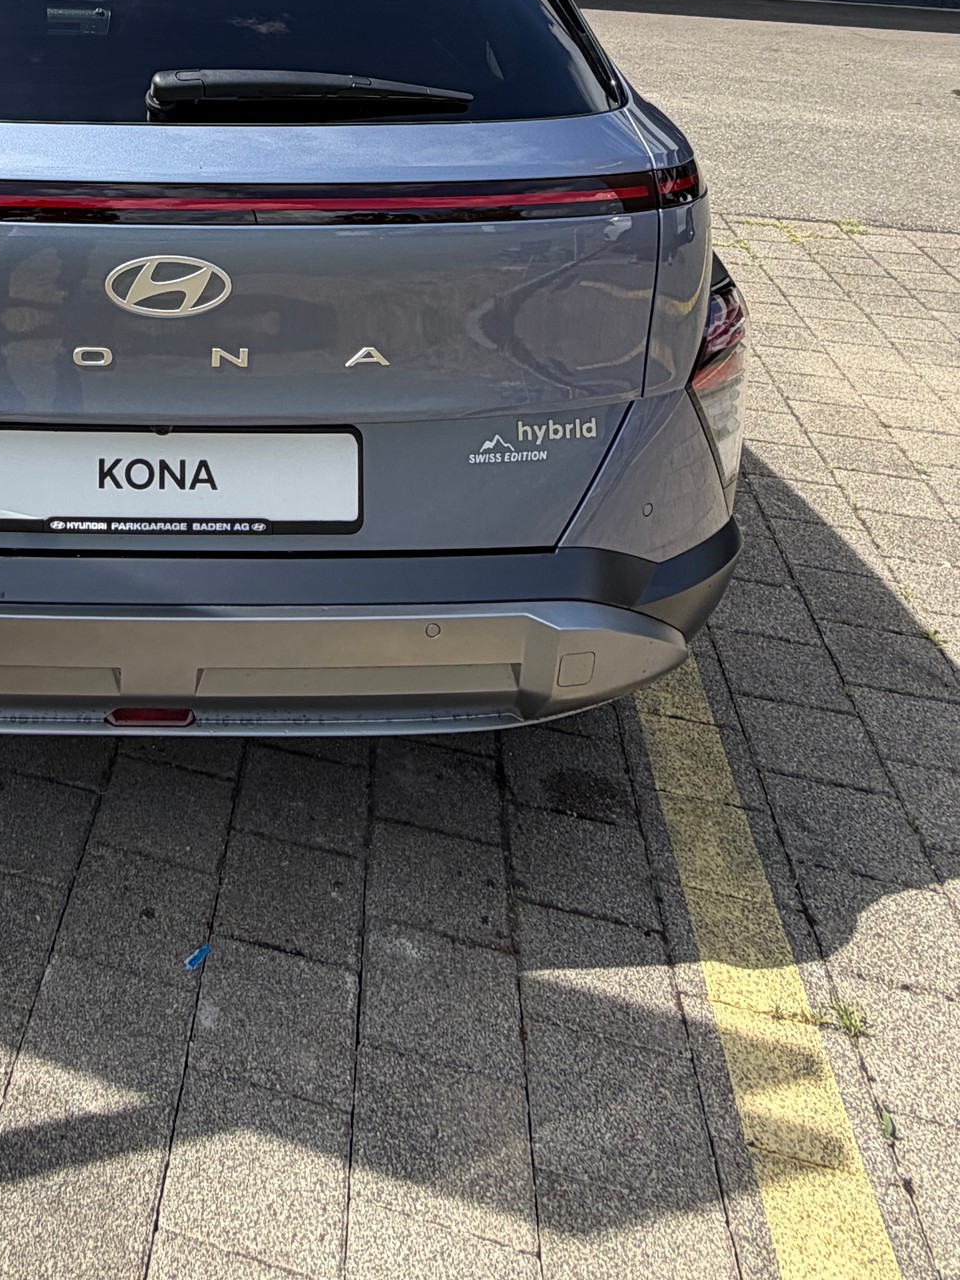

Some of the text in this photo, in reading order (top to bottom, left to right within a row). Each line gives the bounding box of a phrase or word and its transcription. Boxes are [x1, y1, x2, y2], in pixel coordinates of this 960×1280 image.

[517, 417, 597, 445] hybrid
[468, 450, 548, 464] SWISS EDITION
[98, 459, 218, 491] KONA
[66, 521, 250, 532] HYUNDAI PARKGARAGE BADEN AG
